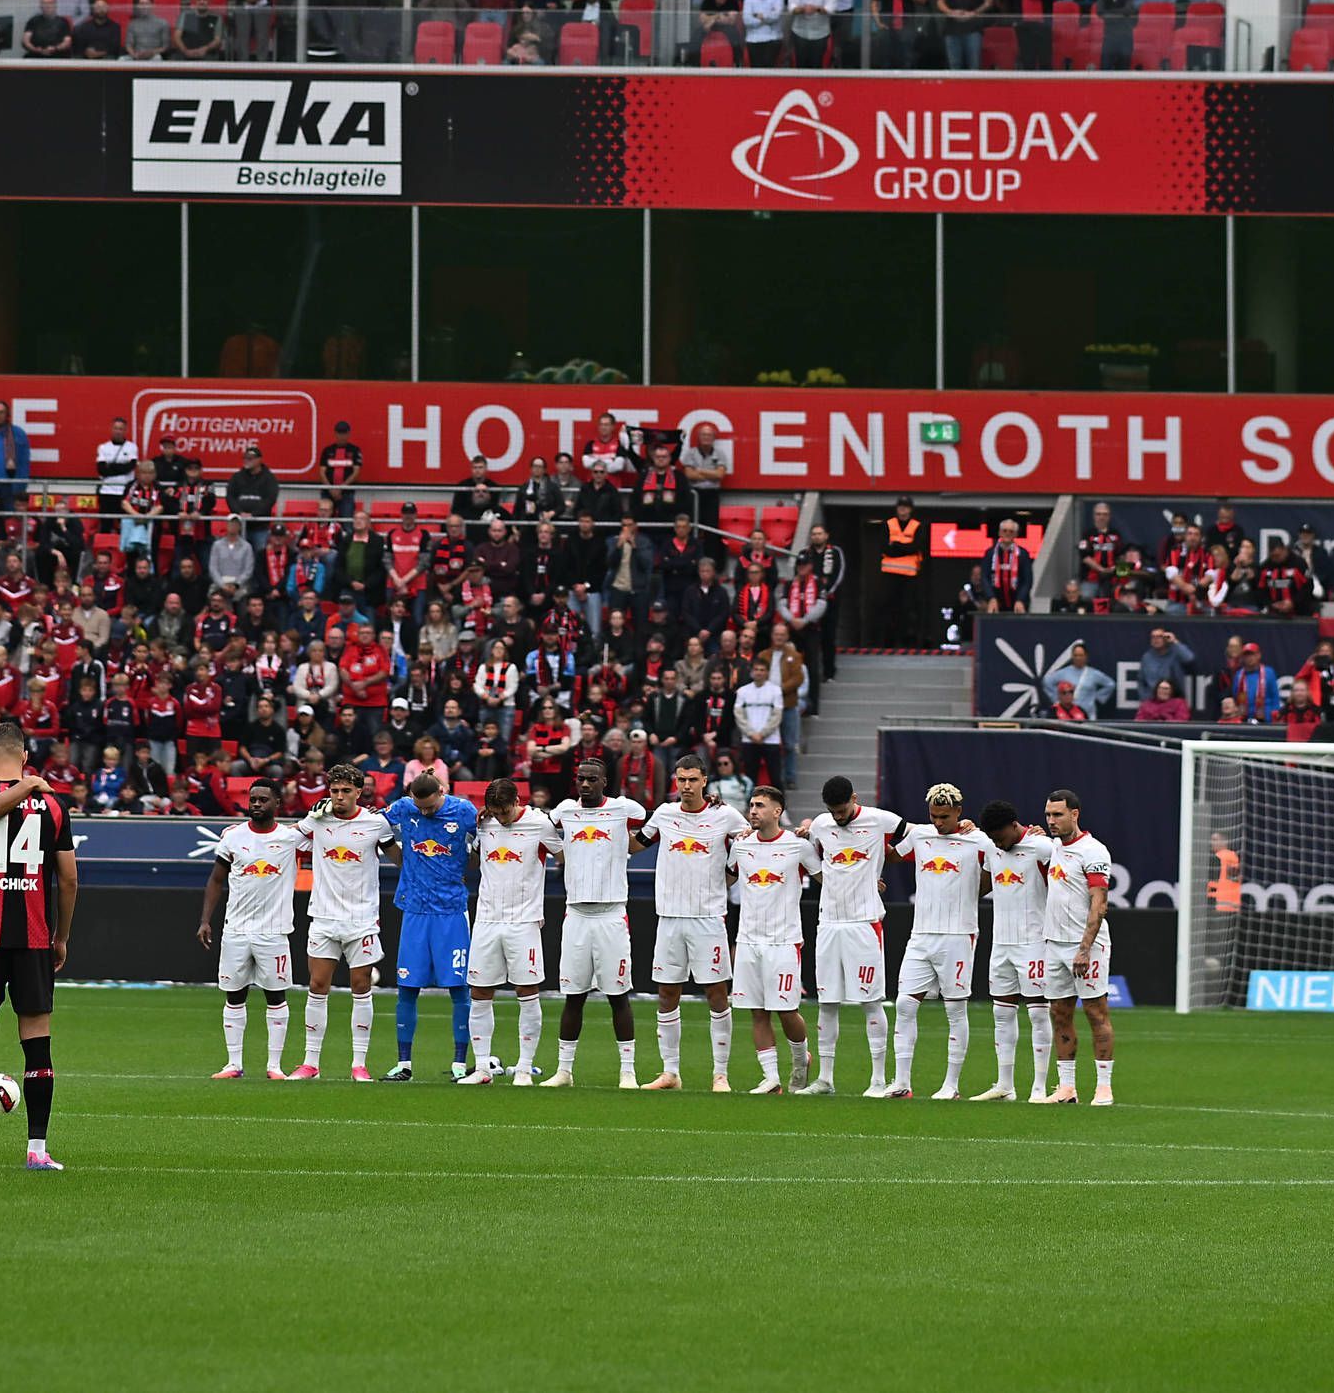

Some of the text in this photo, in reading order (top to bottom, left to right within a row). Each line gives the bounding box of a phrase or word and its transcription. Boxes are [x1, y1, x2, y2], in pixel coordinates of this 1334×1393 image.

[149, 80, 387, 160] EMKA
[875, 110, 1100, 162] NIEDAX
[237, 165, 387, 192] Beschlagteile
[874, 167, 1021, 201] GROUP
[160, 413, 295, 434] HOTTGENROTH
[161, 436, 259, 453] OFTWARE
[274, 955, 287, 974] 17
[452, 949, 467, 968] 26
[528, 948, 535, 967] 4
[713, 946, 721, 965] 3
[618, 959, 626, 977] 6
[858, 966, 875, 984] 40
[956, 960, 964, 980] 7
[1028, 960, 1045, 979] 28
[778, 973, 793, 992] 10
